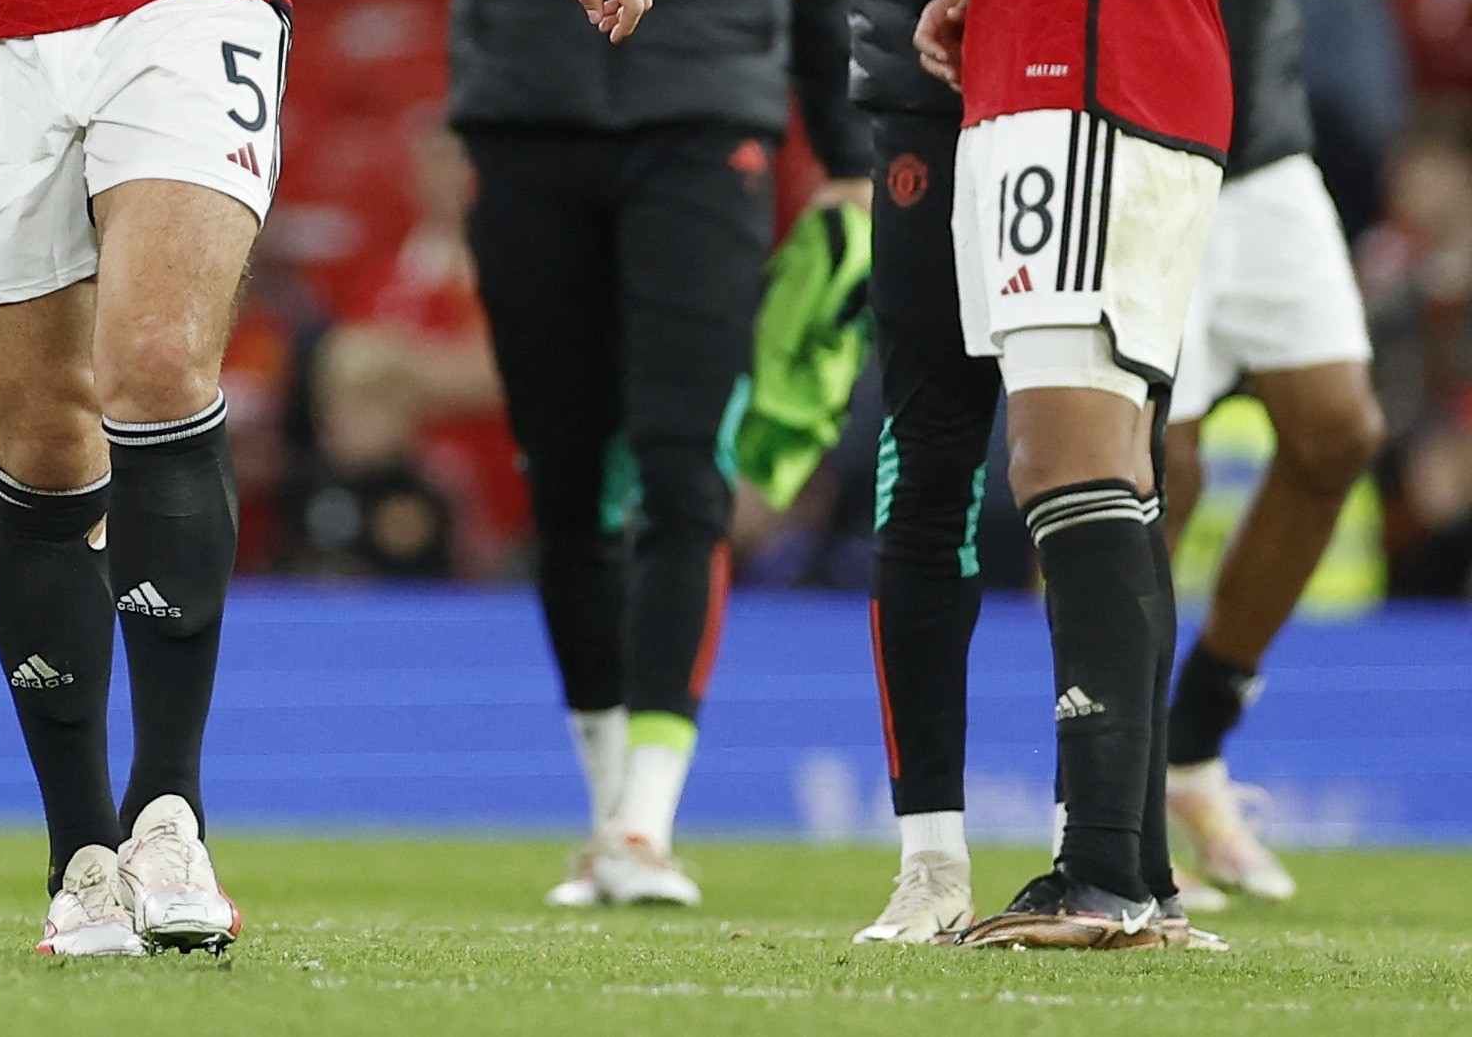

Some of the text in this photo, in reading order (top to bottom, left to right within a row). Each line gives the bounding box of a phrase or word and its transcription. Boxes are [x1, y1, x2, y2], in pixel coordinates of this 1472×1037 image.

[221, 40, 267, 132] 5
[998, 165, 1056, 261] 18
[116, 601, 183, 618] adidas
[11, 673, 75, 689] adidas
